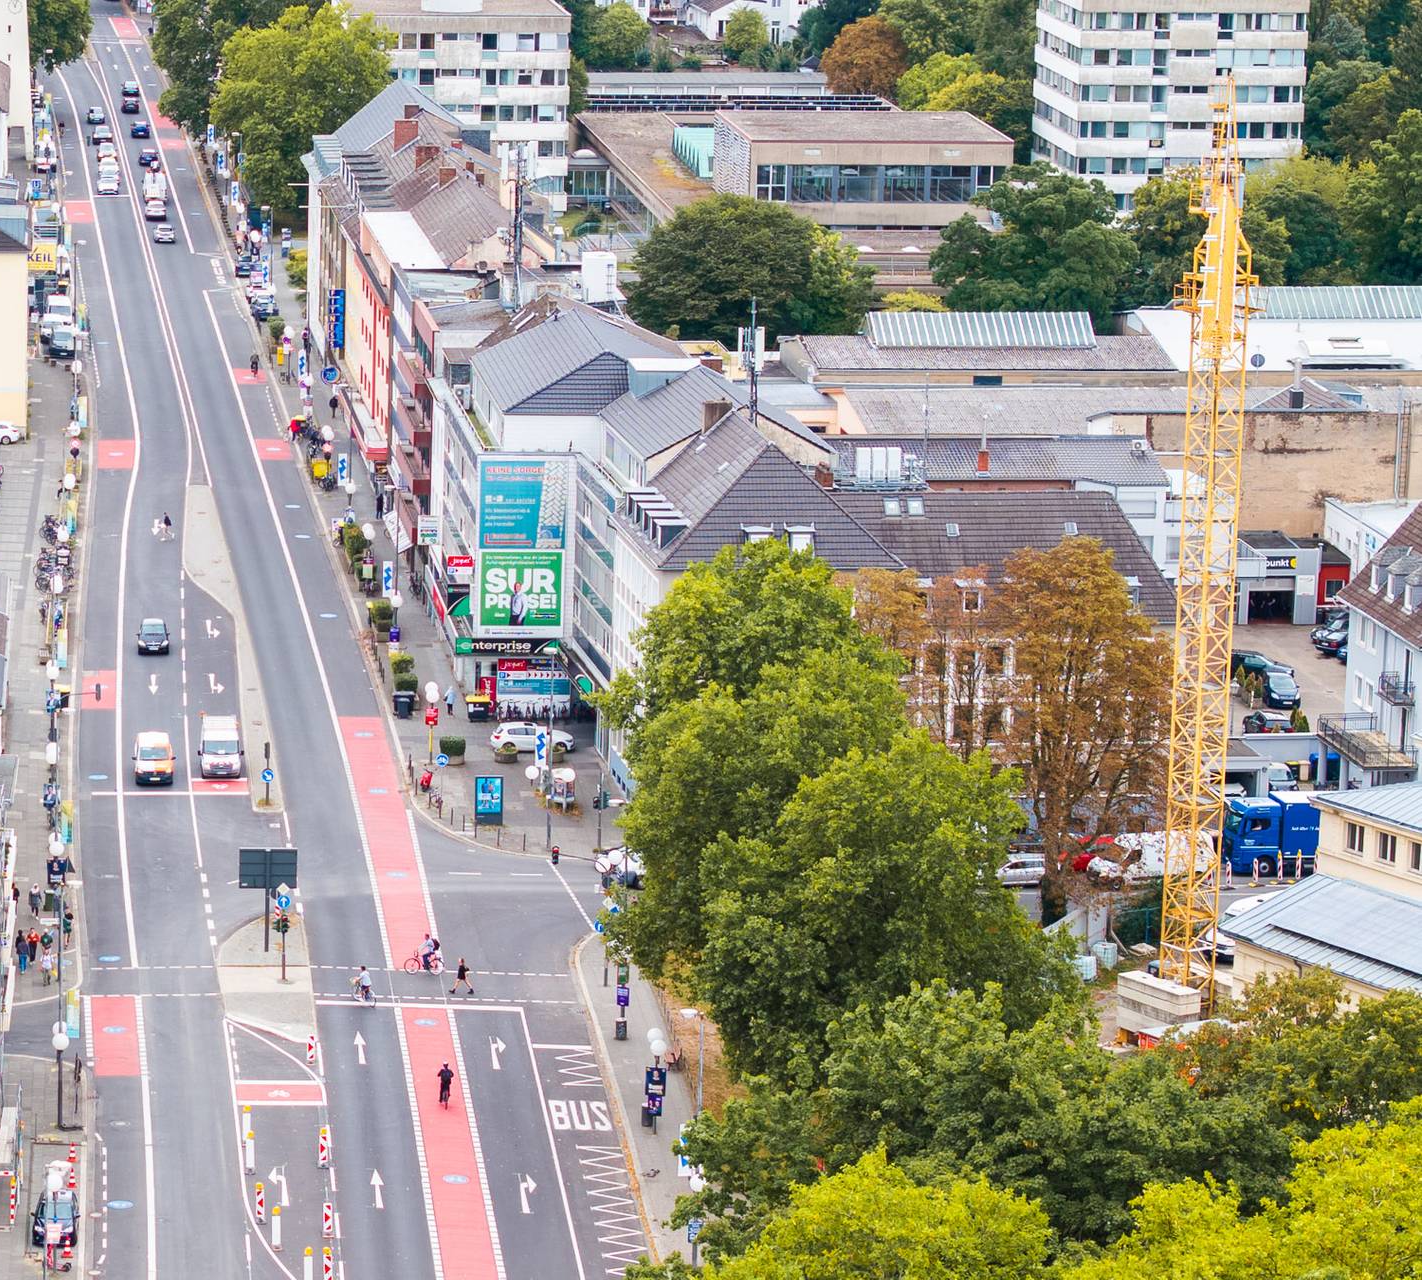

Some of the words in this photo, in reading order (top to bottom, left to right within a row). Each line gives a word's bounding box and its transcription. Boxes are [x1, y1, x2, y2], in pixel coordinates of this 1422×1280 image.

[27, 252, 53, 262] KEIL
[484, 567, 556, 593] SUR
[485, 593, 557, 609] PRSE!
[459, 640, 531, 654] enterprise
[548, 1099, 613, 1131] BUS
